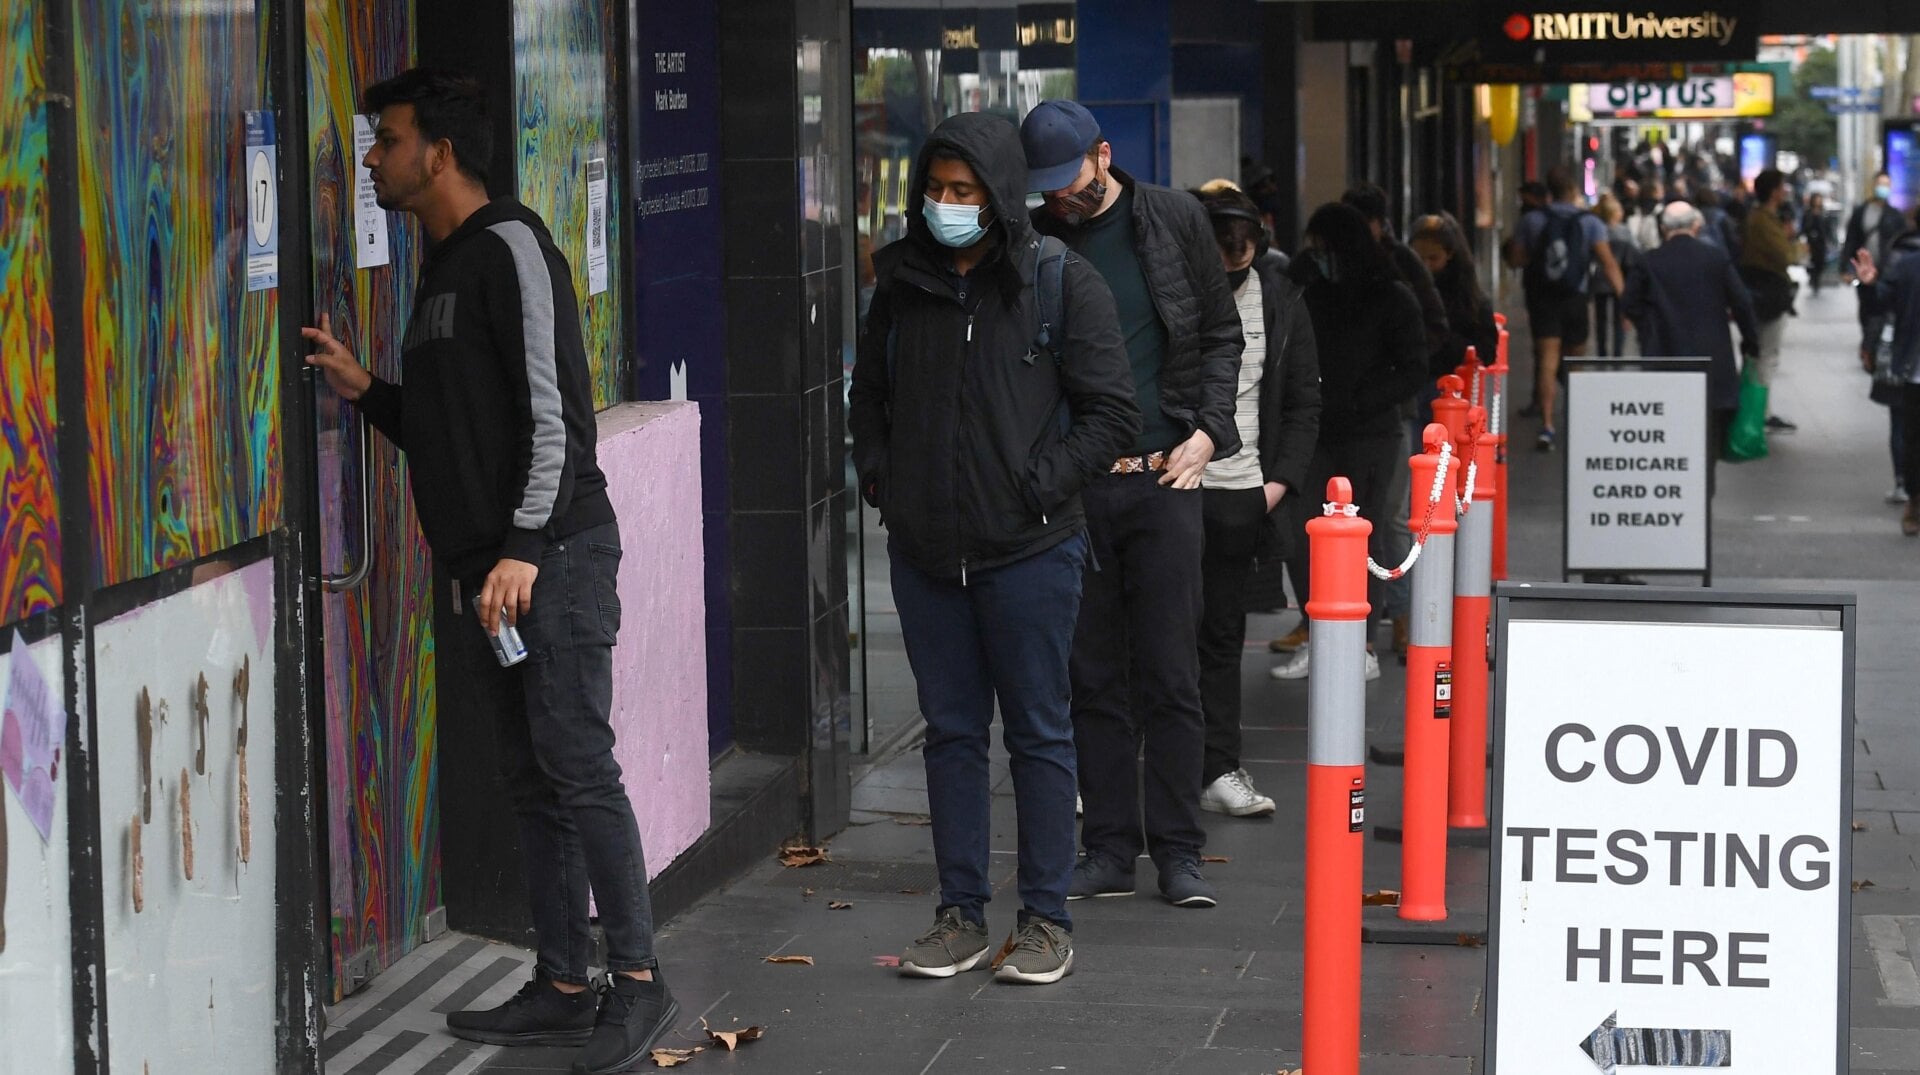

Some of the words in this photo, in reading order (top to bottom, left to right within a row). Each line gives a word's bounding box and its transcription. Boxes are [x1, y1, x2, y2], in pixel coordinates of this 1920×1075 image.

[1533, 12, 1611, 40] RMIT
[1612, 12, 1738, 46] University
[655, 52, 666, 73] THE
[667, 52, 686, 73] ARTIST
[655, 88, 668, 111] Mark
[1607, 80, 1716, 107] OPTUS
[254, 179, 268, 224] 17
[1610, 402, 1664, 416] HAVE
[1609, 429, 1665, 443] YOUR
[1585, 457, 1689, 471] MEDICARE
[1592, 484, 1647, 499] CARD
[1653, 484, 1682, 499] OR
[1590, 512, 1610, 527] ID
[1616, 512, 1684, 527] READY
[1545, 723, 1798, 788] COVID
[1507, 827, 1831, 891] TESTING
[1566, 927, 1770, 988] HERE
